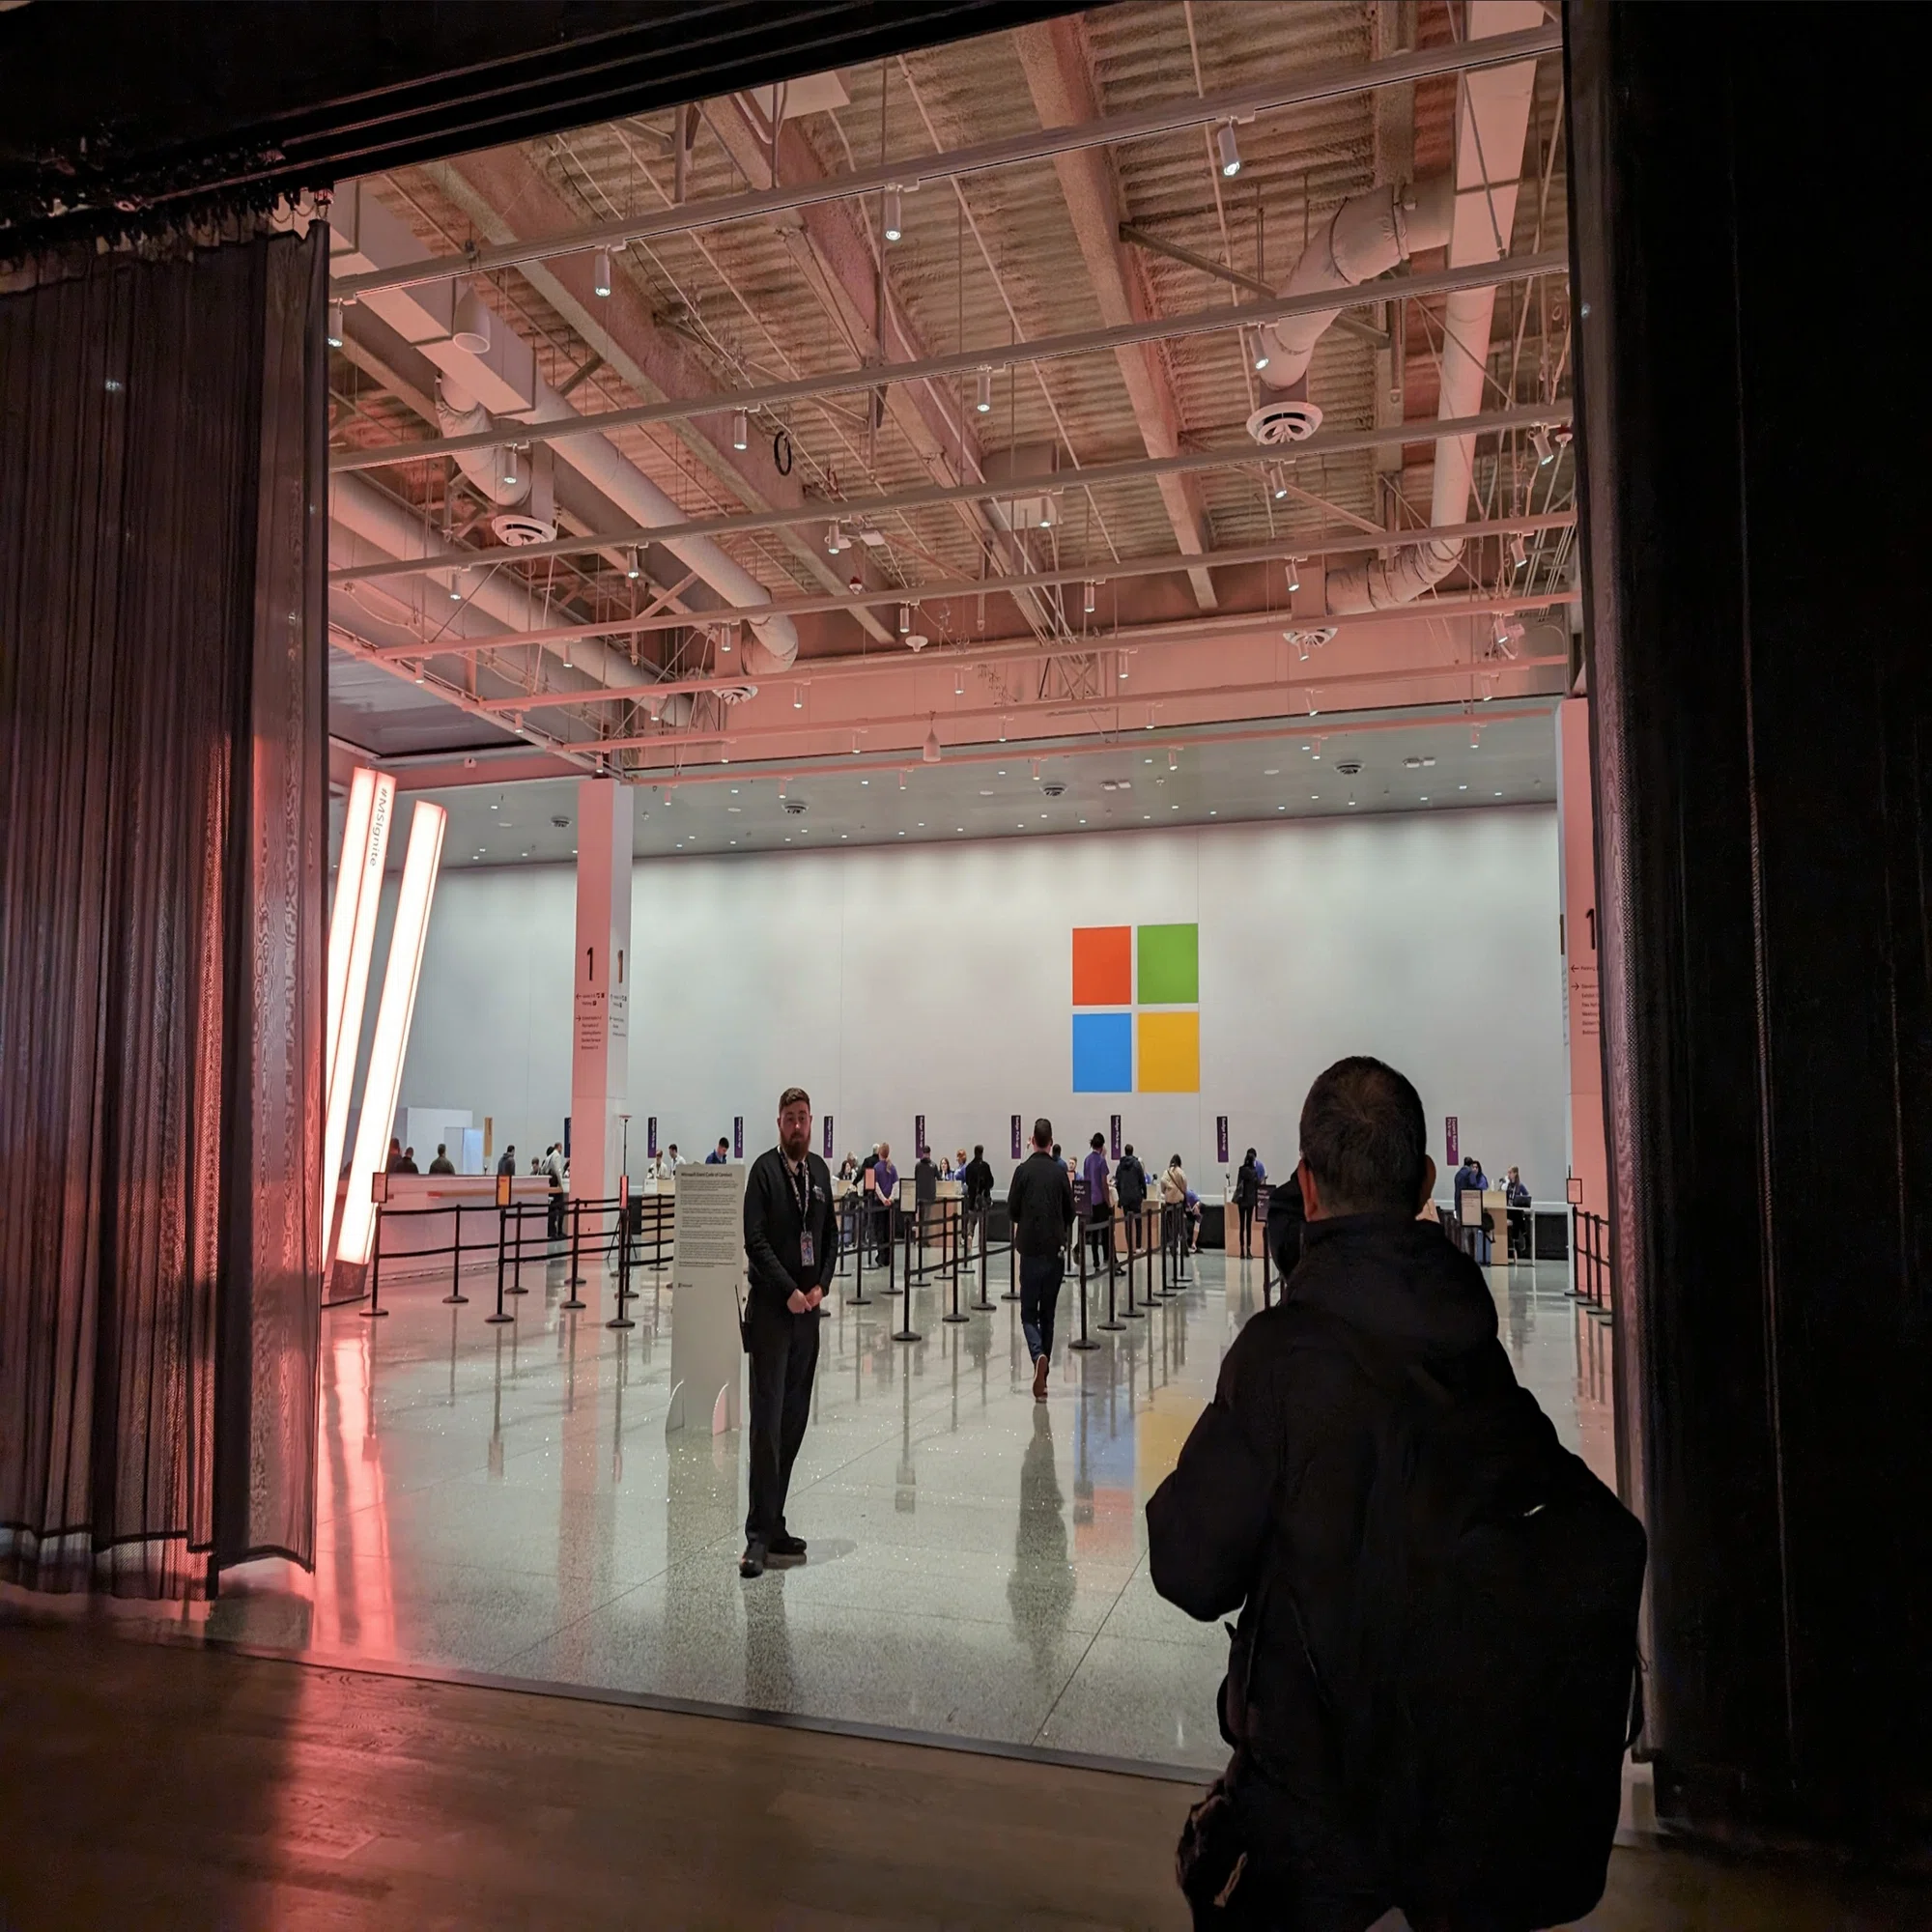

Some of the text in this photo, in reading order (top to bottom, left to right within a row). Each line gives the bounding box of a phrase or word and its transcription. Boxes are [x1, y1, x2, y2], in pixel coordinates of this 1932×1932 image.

[370, 787, 388, 867] #MSIgnite
[1585, 908, 1596, 950] 1
[586, 947, 594, 981] 1
[617, 950, 624, 983] 1
